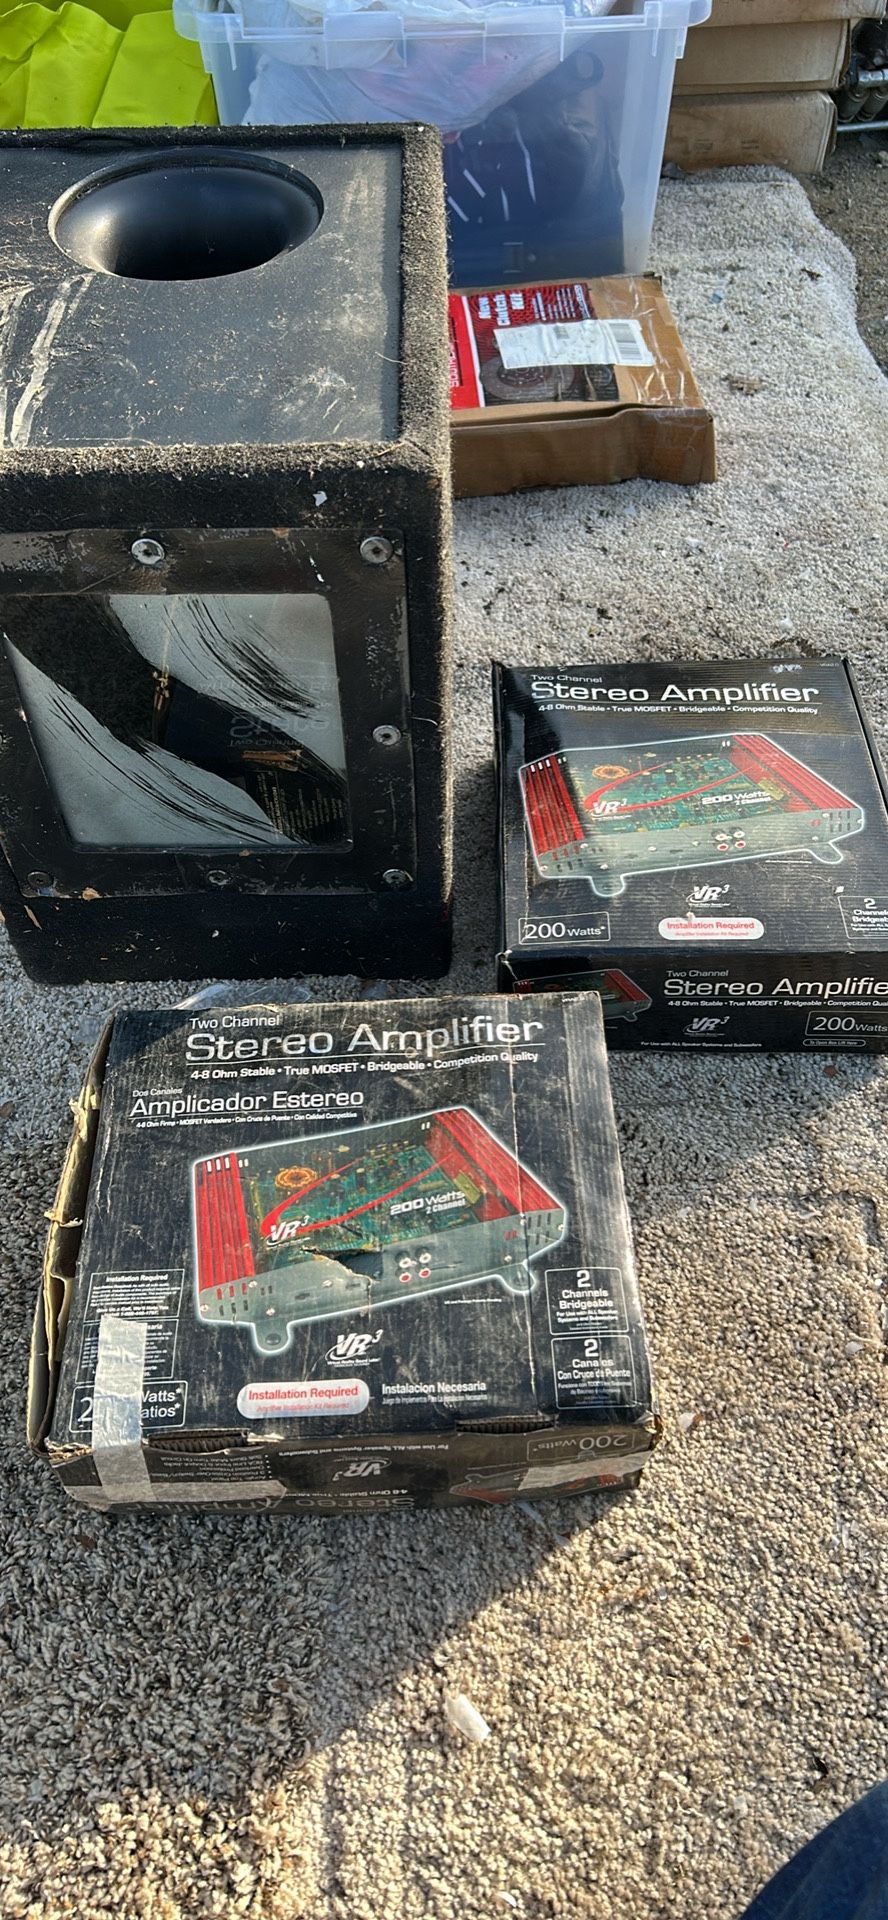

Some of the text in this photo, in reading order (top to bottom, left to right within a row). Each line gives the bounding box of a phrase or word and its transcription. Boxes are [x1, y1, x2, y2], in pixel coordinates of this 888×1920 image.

[478, 296, 491, 319] New
[510, 293, 525, 310] Kit
[493, 294, 511, 325] Clutch
[556, 674, 603, 683] Channel
[531, 681, 820, 705] Stereo Amplifier
[538, 703, 818, 715] 4-8 Ohm Stable True MOSFET Bridgeable Competition Quality
[701, 794, 733, 805] 200
[733, 791, 771, 800] Watts
[863, 897, 878, 910] 2
[524, 922, 566, 939] 200
[667, 921, 755, 931] Installation Required
[666, 969, 729, 978] Two Channel
[663, 977, 888, 999] Stereo Amplifie
[783, 1000, 822, 1008] Bridgeable
[827, 1000, 872, 1008] Competition
[189, 1015, 280, 1029] Two Channel
[813, 1016, 856, 1031] 200
[185, 1016, 543, 1061] Stereo Amplifier
[190, 1069, 210, 1080] 4-8
[212, 1069, 238, 1079] Ohm
[240, 1067, 276, 1077] Stable
[284, 1065, 309, 1075] True
[312, 1062, 359, 1074] MOSFET
[367, 1061, 425, 1072] Bridgeable
[433, 1053, 499, 1068] Competition
[150, 1087, 183, 1096] Canales
[129, 1090, 364, 1118] Amplicador Estereo
[179, 1118, 202, 1126] MOSFET
[390, 1191, 466, 1216] 200 Watts
[425, 1198, 466, 1215] 2 Channel
[105, 1273, 169, 1283] Installation Required
[576, 1269, 591, 1288] 2
[561, 1288, 609, 1299] Channels
[558, 1298, 614, 1310] Bridgeable
[583, 1338, 599, 1357] 2
[572, 1358, 615, 1368] Canaes
[557, 1370, 572, 1380] Con
[572, 1369, 595, 1379] Cruce
[605, 1367, 631, 1378] Puente
[248, 1385, 358, 1401] Installation Required
[381, 1380, 487, 1395] Instalacion Necesaria
[578, 1434, 628, 1450] 200
[294, 1497, 416, 1509] Stereo
